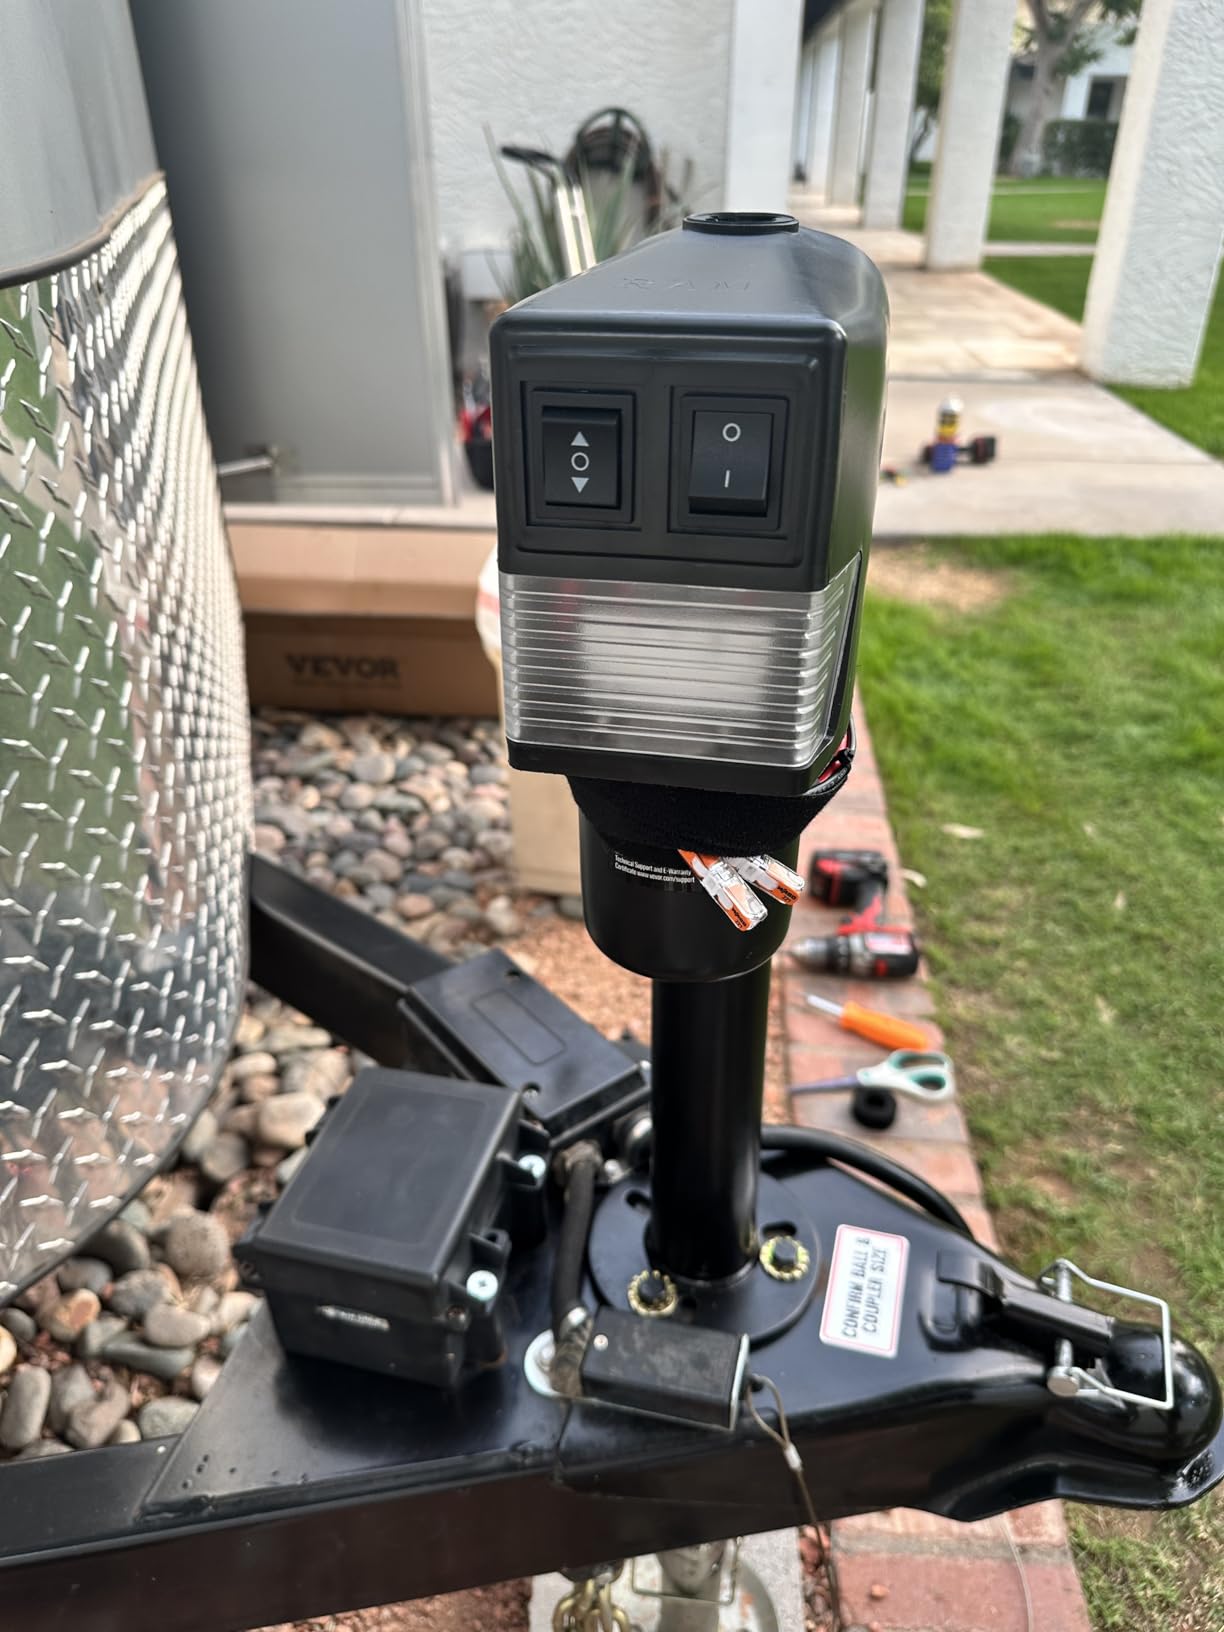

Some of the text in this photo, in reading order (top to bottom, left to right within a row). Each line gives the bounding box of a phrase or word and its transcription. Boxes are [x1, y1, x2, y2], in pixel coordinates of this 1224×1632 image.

[285, 654, 399, 680] VEVOR
[615, 855, 635, 867] Technical
[635, 861, 653, 872] Support
[615, 862, 637, 876] Certificate
[851, 1251, 869, 1278] BALL
[862, 1248, 888, 1333] COUPLER SIZE
[842, 1281, 863, 1338] CONFIRM
